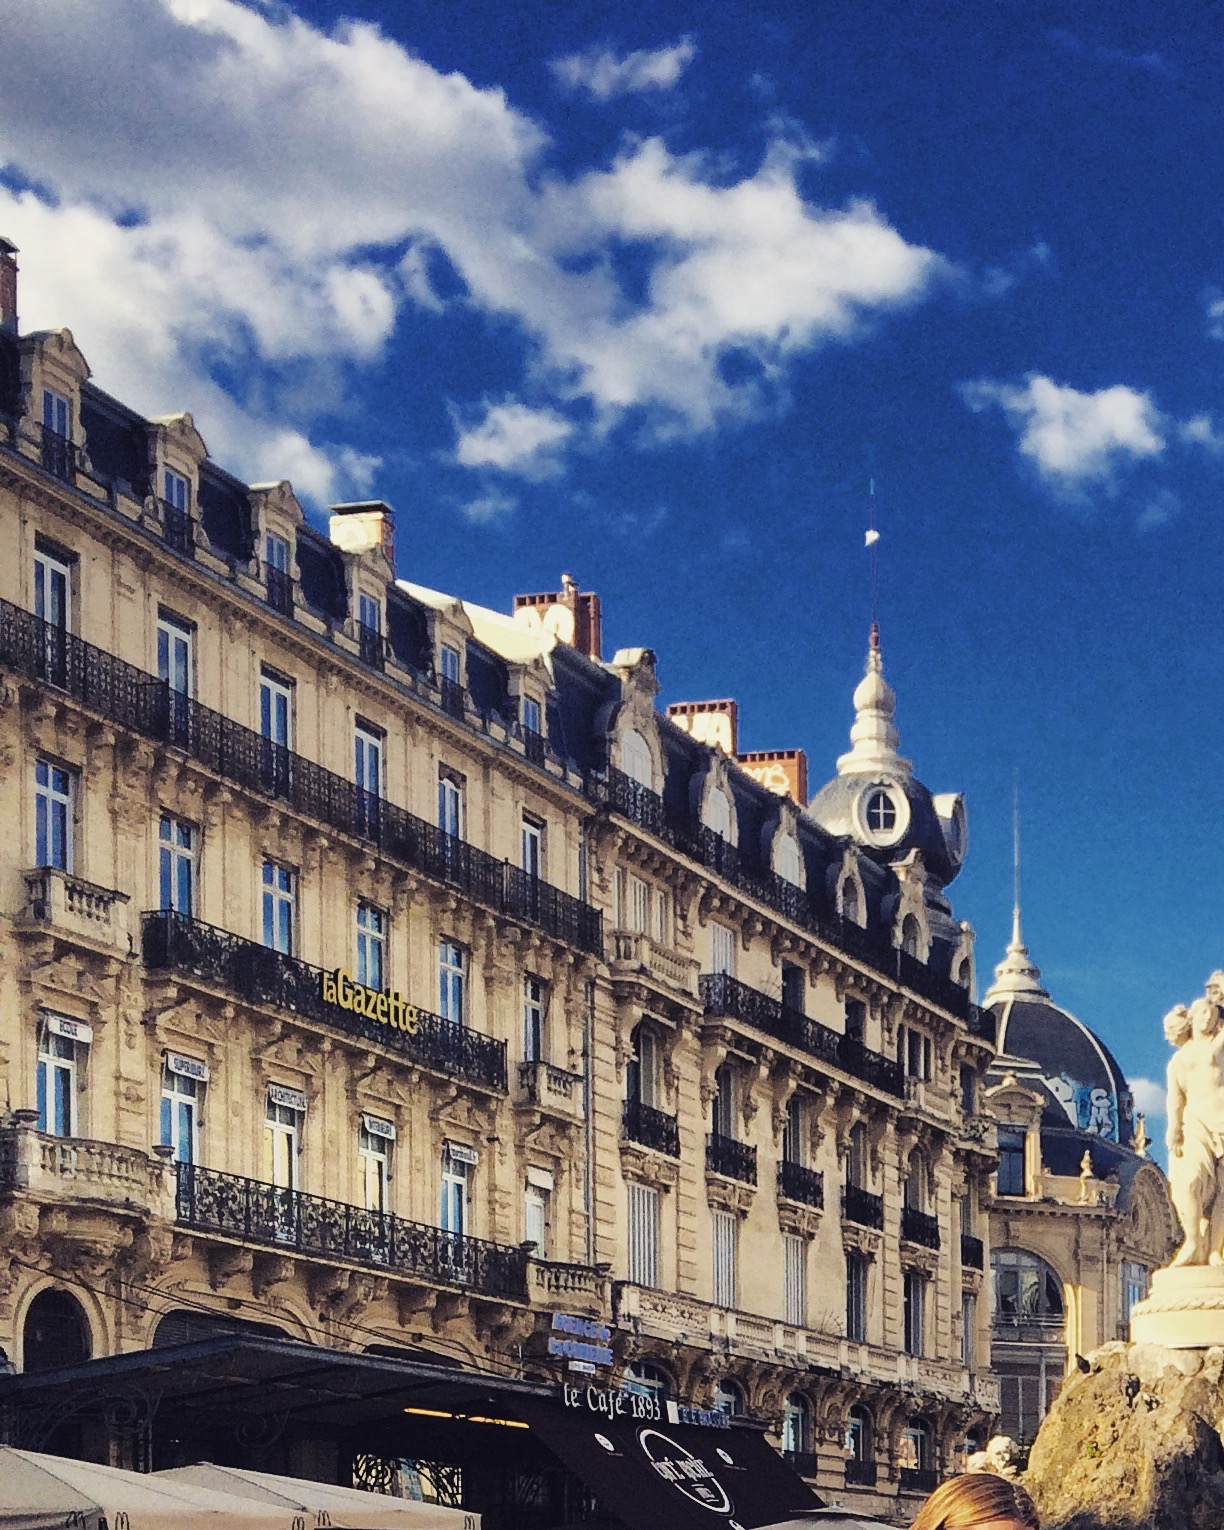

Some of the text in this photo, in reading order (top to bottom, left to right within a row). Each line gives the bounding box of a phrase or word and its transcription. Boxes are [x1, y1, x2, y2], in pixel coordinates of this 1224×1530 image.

[563, 1382, 583, 1408] le
[586, 1385, 627, 1420] Café
[630, 1395, 662, 1421] 1893
